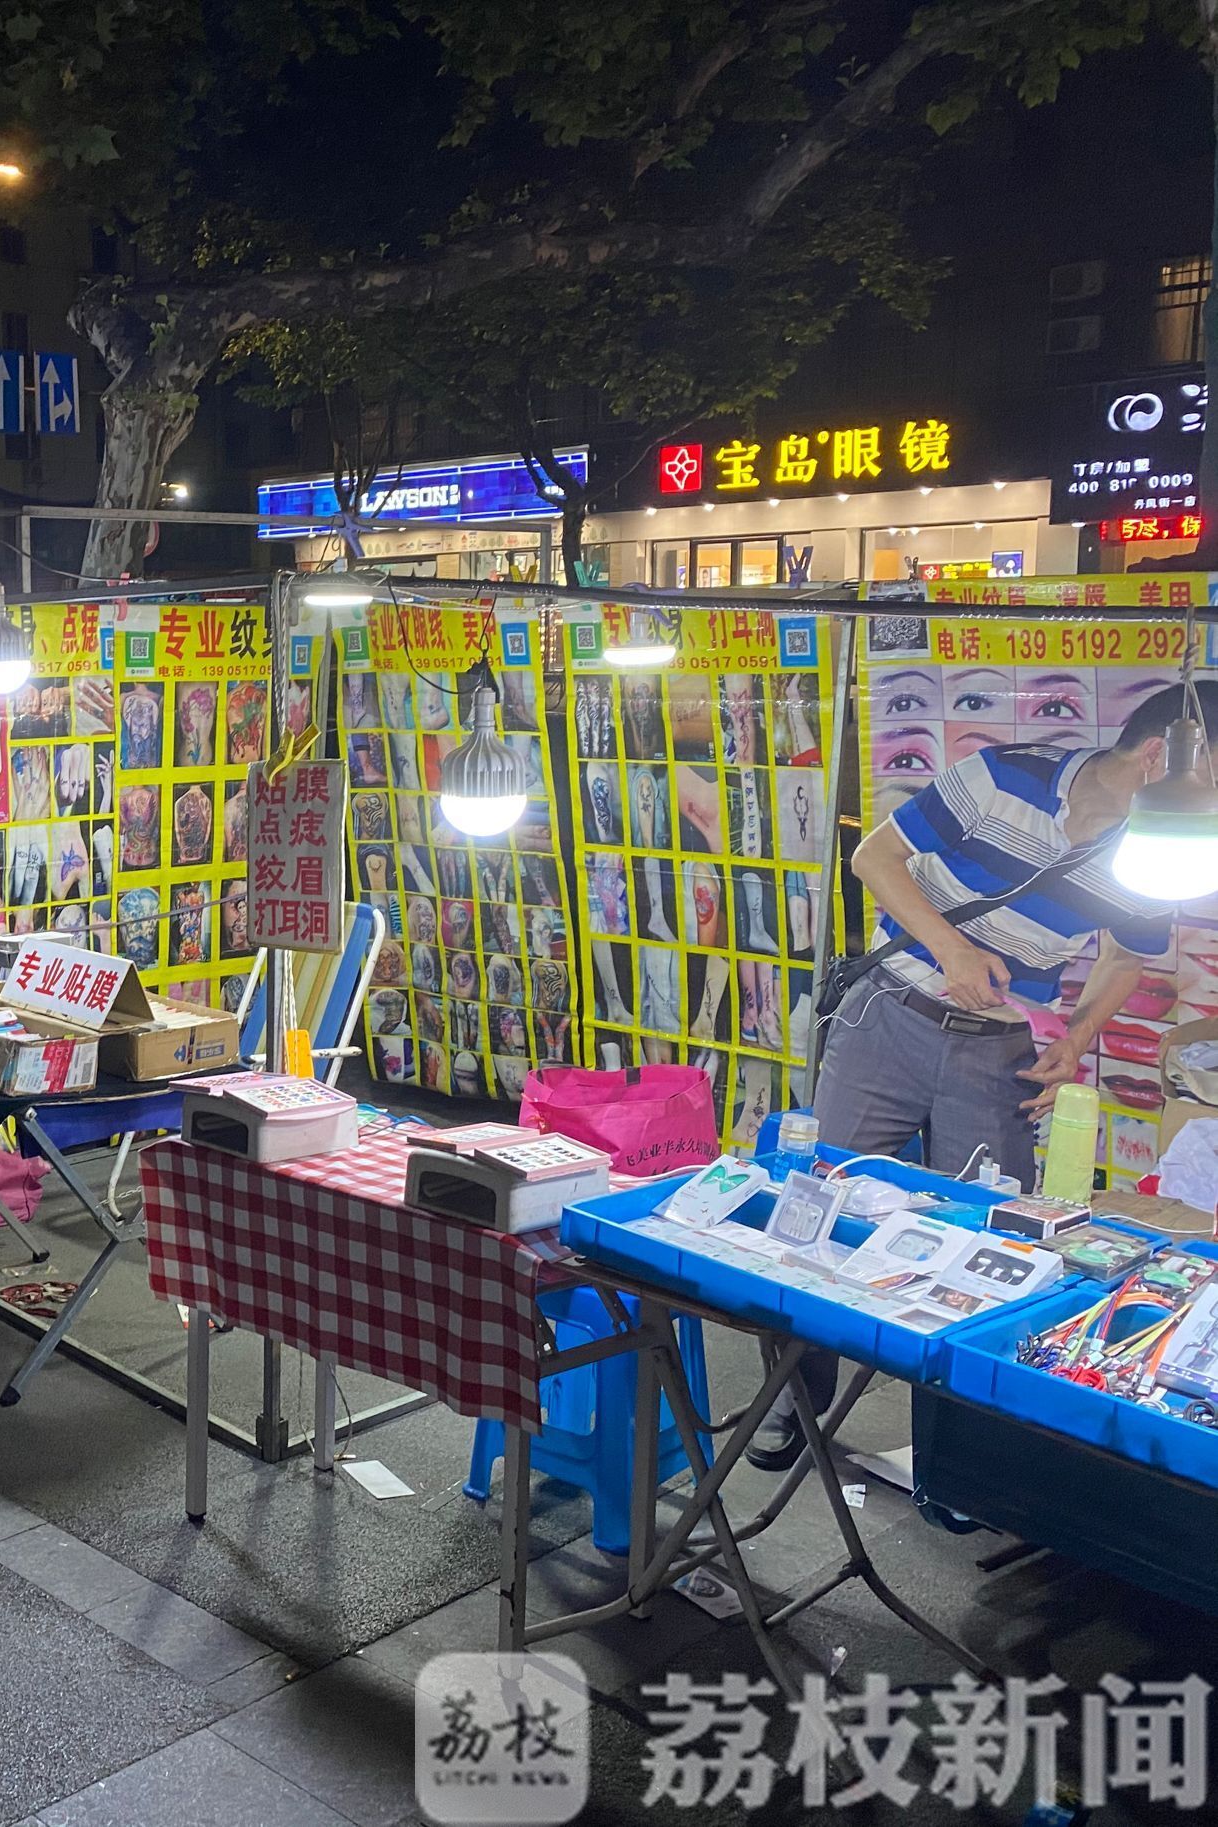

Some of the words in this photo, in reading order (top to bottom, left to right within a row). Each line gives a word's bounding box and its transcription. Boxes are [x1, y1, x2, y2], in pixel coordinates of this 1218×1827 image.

[1068, 481, 1100, 494] 400
[1148, 473, 1194, 489] 0009
[1006, 628, 1047, 660] 139
[1061, 627, 1122, 660] 5192
[67, 660, 100, 672] 0591
[201, 666, 224, 677] 139
[227, 665, 257, 677] 0517
[433, 657, 464, 669] 0517
[690, 656, 731, 669] 0517
[737, 655, 778, 669] 0591
[254, 767, 330, 808] 贴膜
[254, 808, 327, 847] 点痣
[254, 853, 324, 896] 纹眉
[254, 899, 330, 945] 打耳洞
[16, 950, 119, 1013] 专业贴膜
